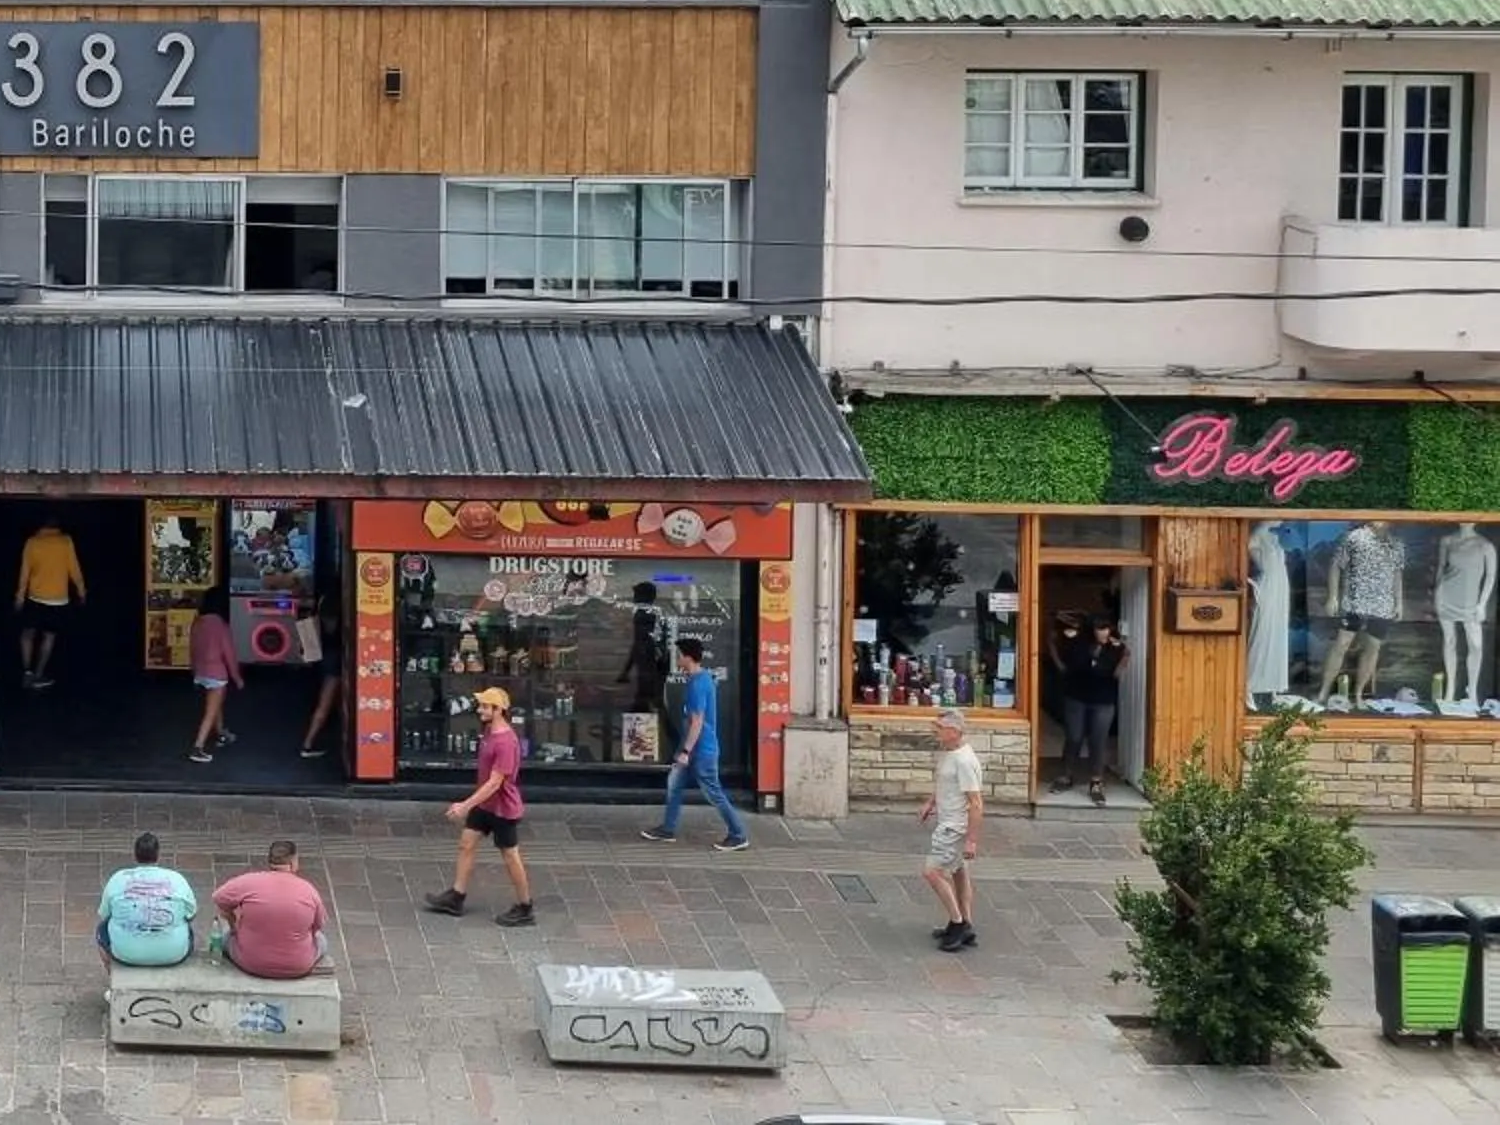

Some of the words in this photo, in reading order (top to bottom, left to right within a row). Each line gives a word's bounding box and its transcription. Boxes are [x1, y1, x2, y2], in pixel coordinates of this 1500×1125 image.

[32, 118, 197, 150] Bariloche
[1154, 415, 1357, 498] Beleza
[488, 556, 616, 576] DRUGSTORE
